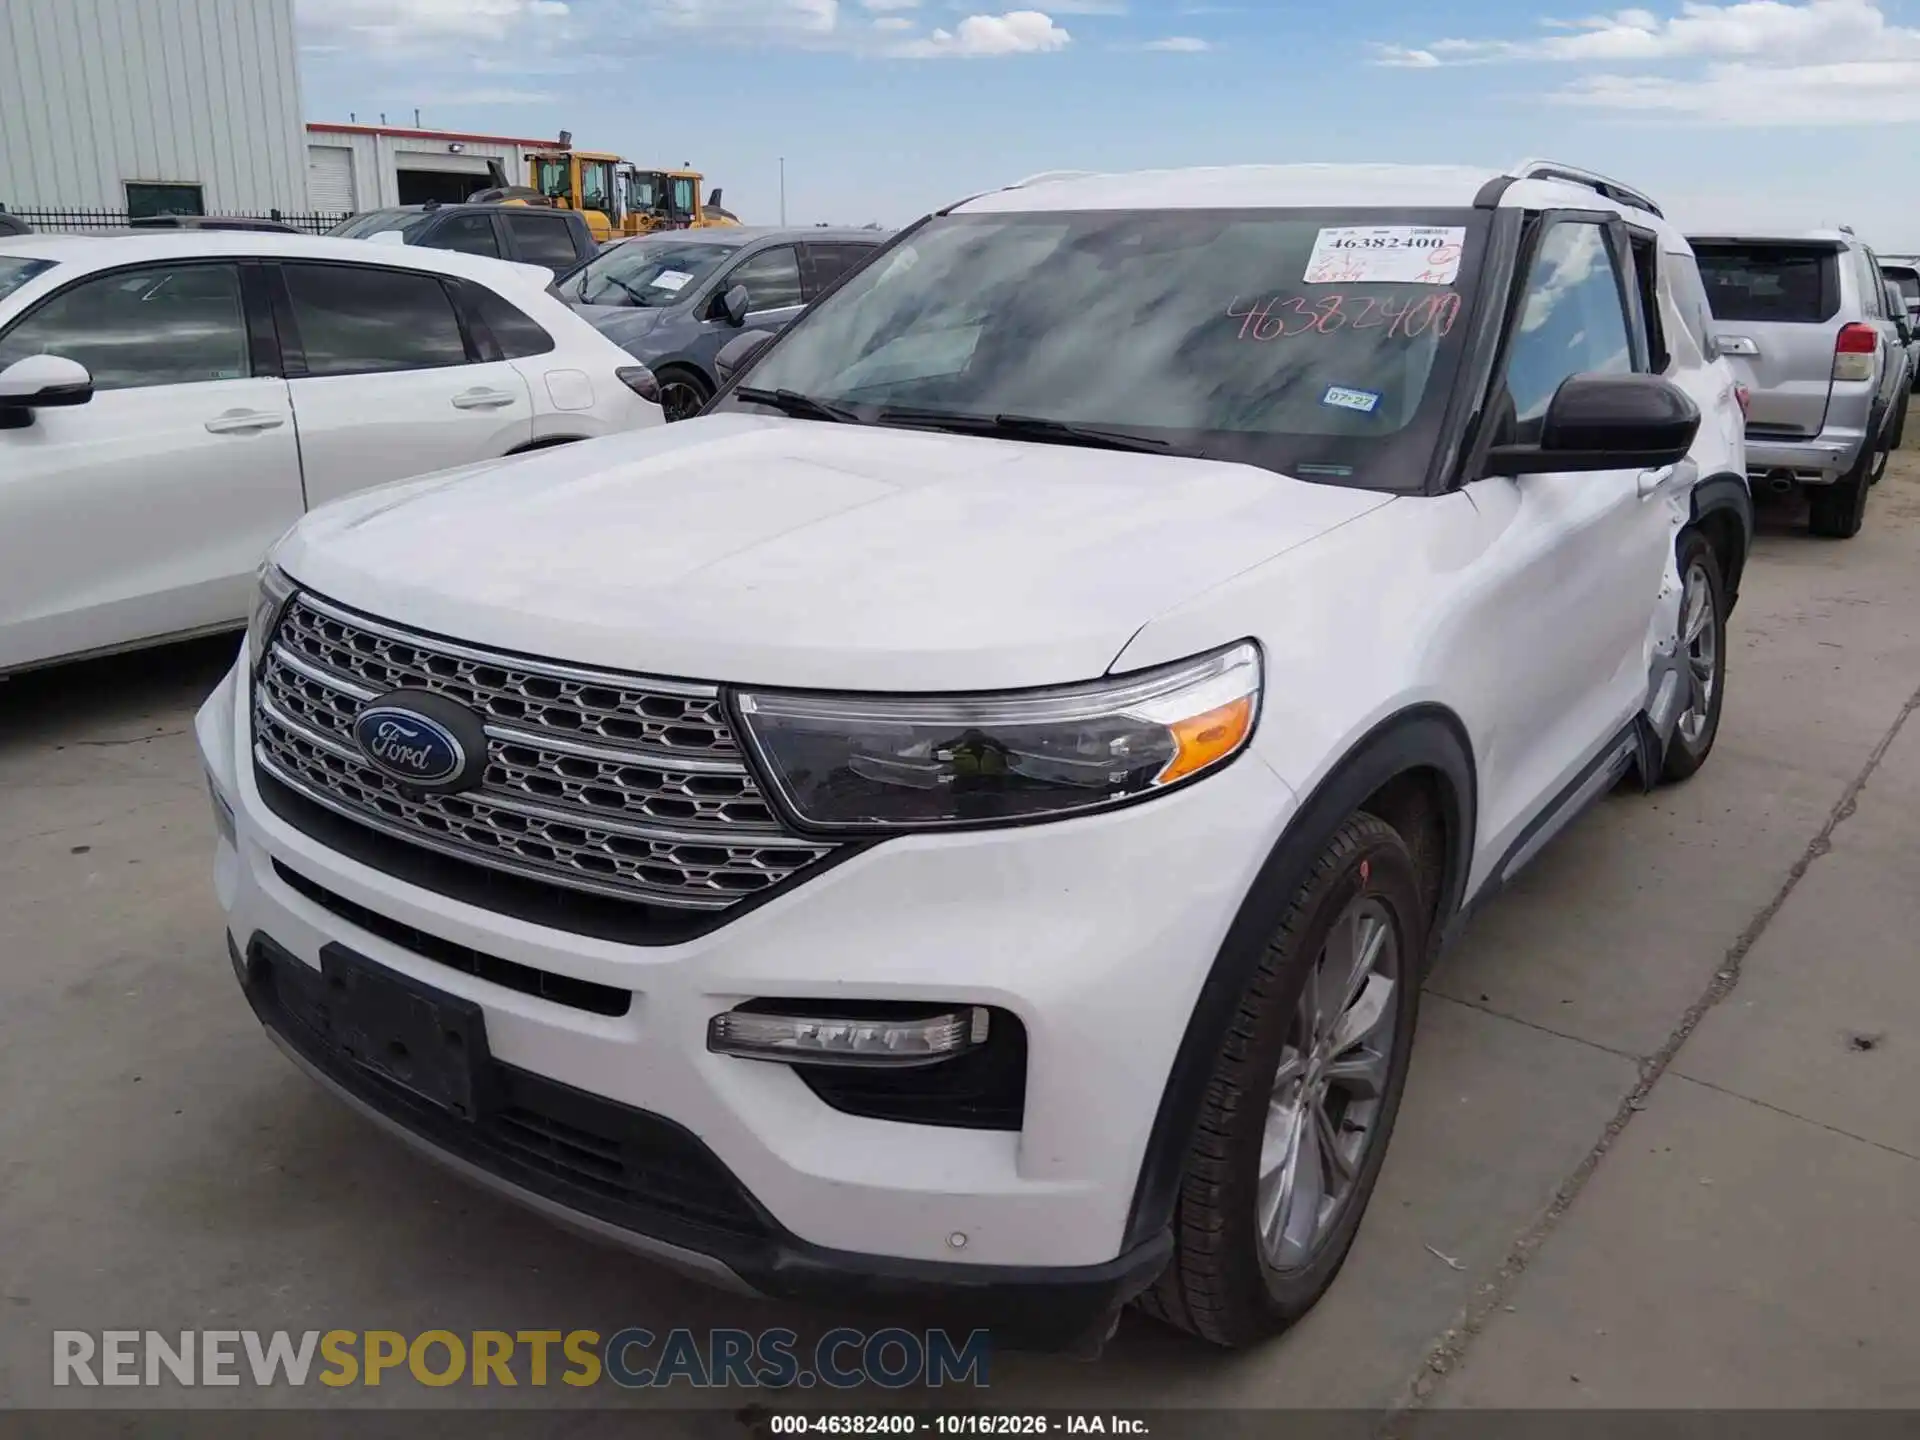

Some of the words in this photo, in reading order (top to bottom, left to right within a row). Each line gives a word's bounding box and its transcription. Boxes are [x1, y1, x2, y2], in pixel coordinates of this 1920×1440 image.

[1329, 237, 1444, 249] 46382400
[1226, 292, 1461, 341] 46382400
[372, 721, 433, 770] Ford
